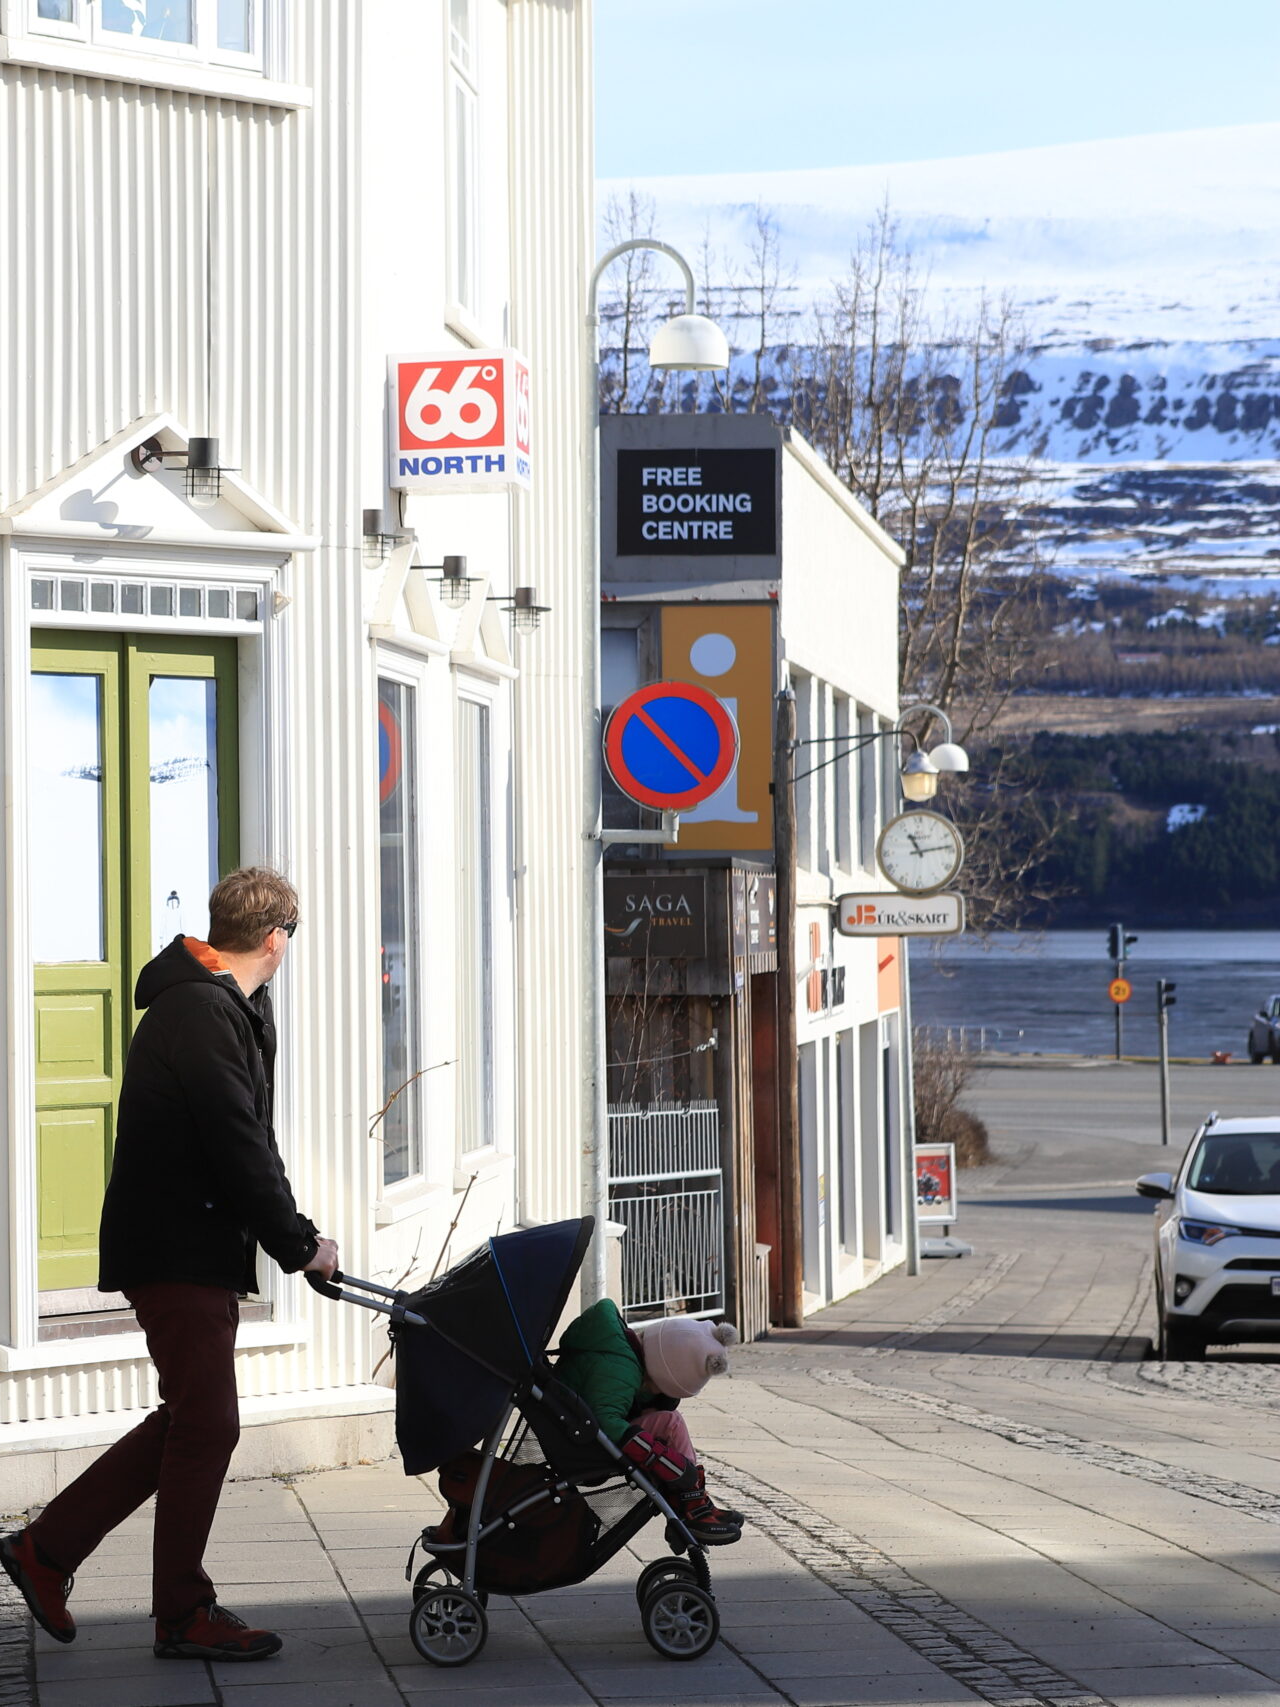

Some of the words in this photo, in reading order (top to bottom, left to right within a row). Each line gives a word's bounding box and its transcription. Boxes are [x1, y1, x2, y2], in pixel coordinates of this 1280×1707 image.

[399, 454, 506, 477] NORTH
[642, 467, 703, 487] FREE
[642, 493, 752, 514] BOOKING
[641, 521, 734, 540] CENTRE
[625, 894, 692, 915] SAGA
[651, 917, 693, 927] TRAVEL
